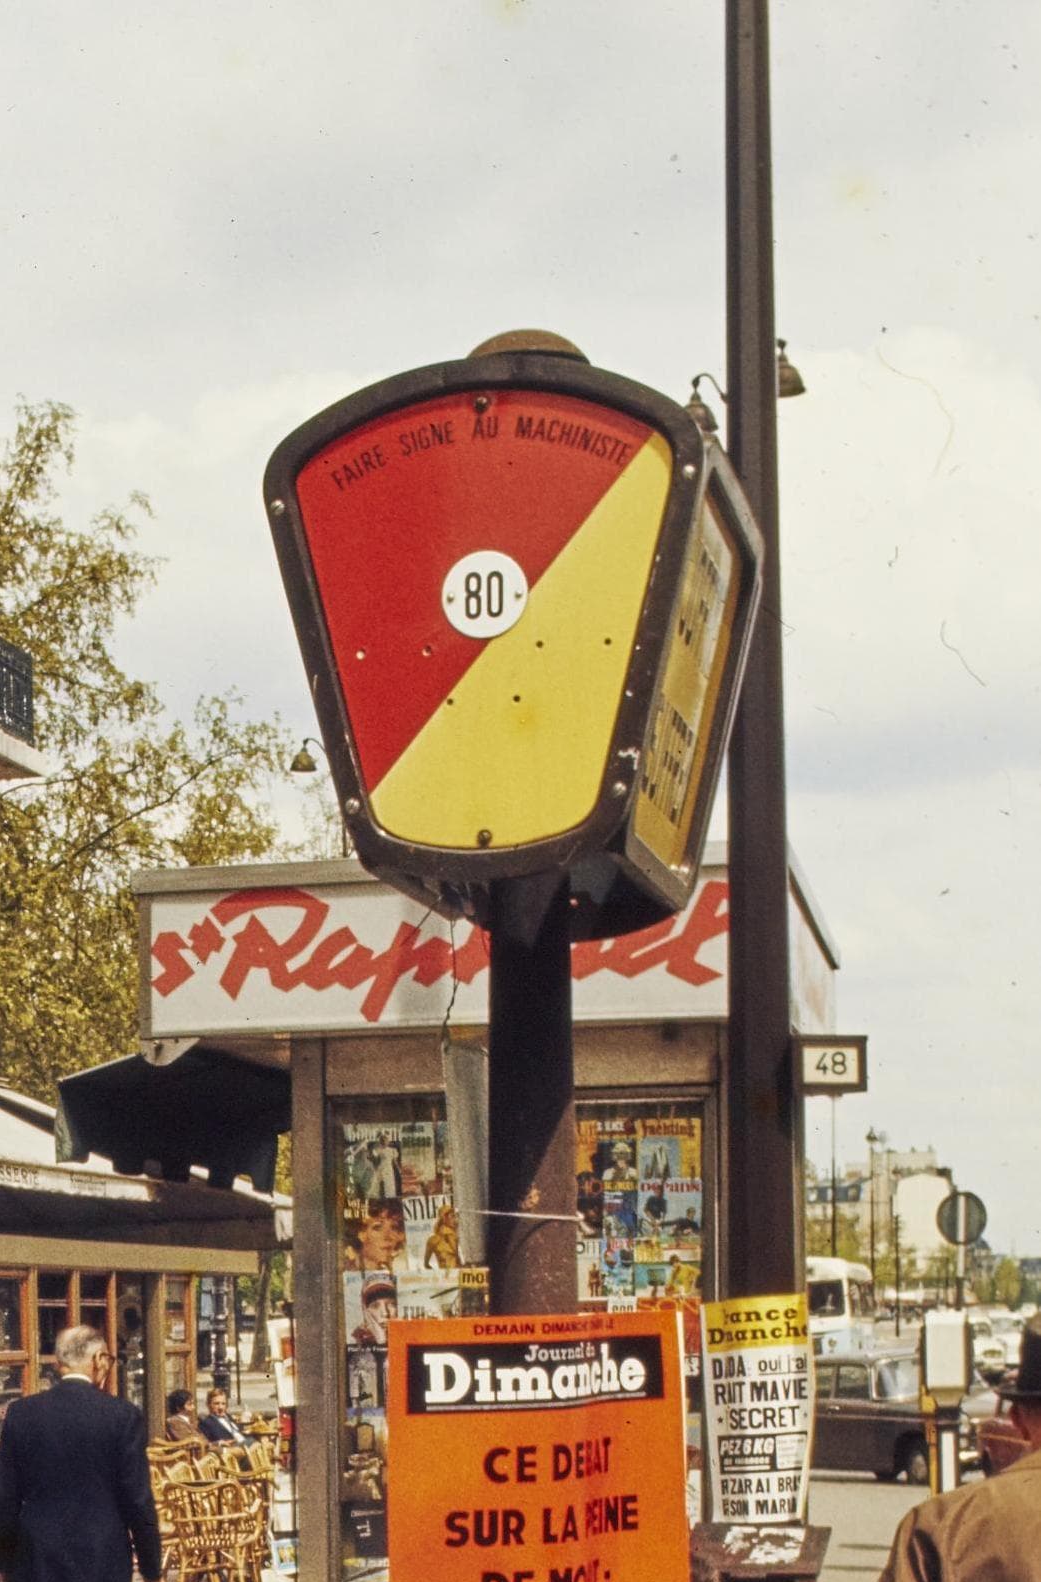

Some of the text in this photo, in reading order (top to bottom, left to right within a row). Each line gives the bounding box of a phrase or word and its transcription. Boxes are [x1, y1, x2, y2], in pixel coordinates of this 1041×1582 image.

[330, 416, 632, 490] FAIRE SIGNE AU MACHINISTE
[464, 571, 505, 619] 80
[815, 1052, 848, 1076] 48
[473, 1324, 536, 1336] DEMAIN
[525, 1342, 584, 1362] Journal
[423, 1342, 646, 1403] Dimanche
[484, 1446, 538, 1484] CE
[445, 1509, 526, 1548] SUR
[542, 1505, 579, 1544] LA
